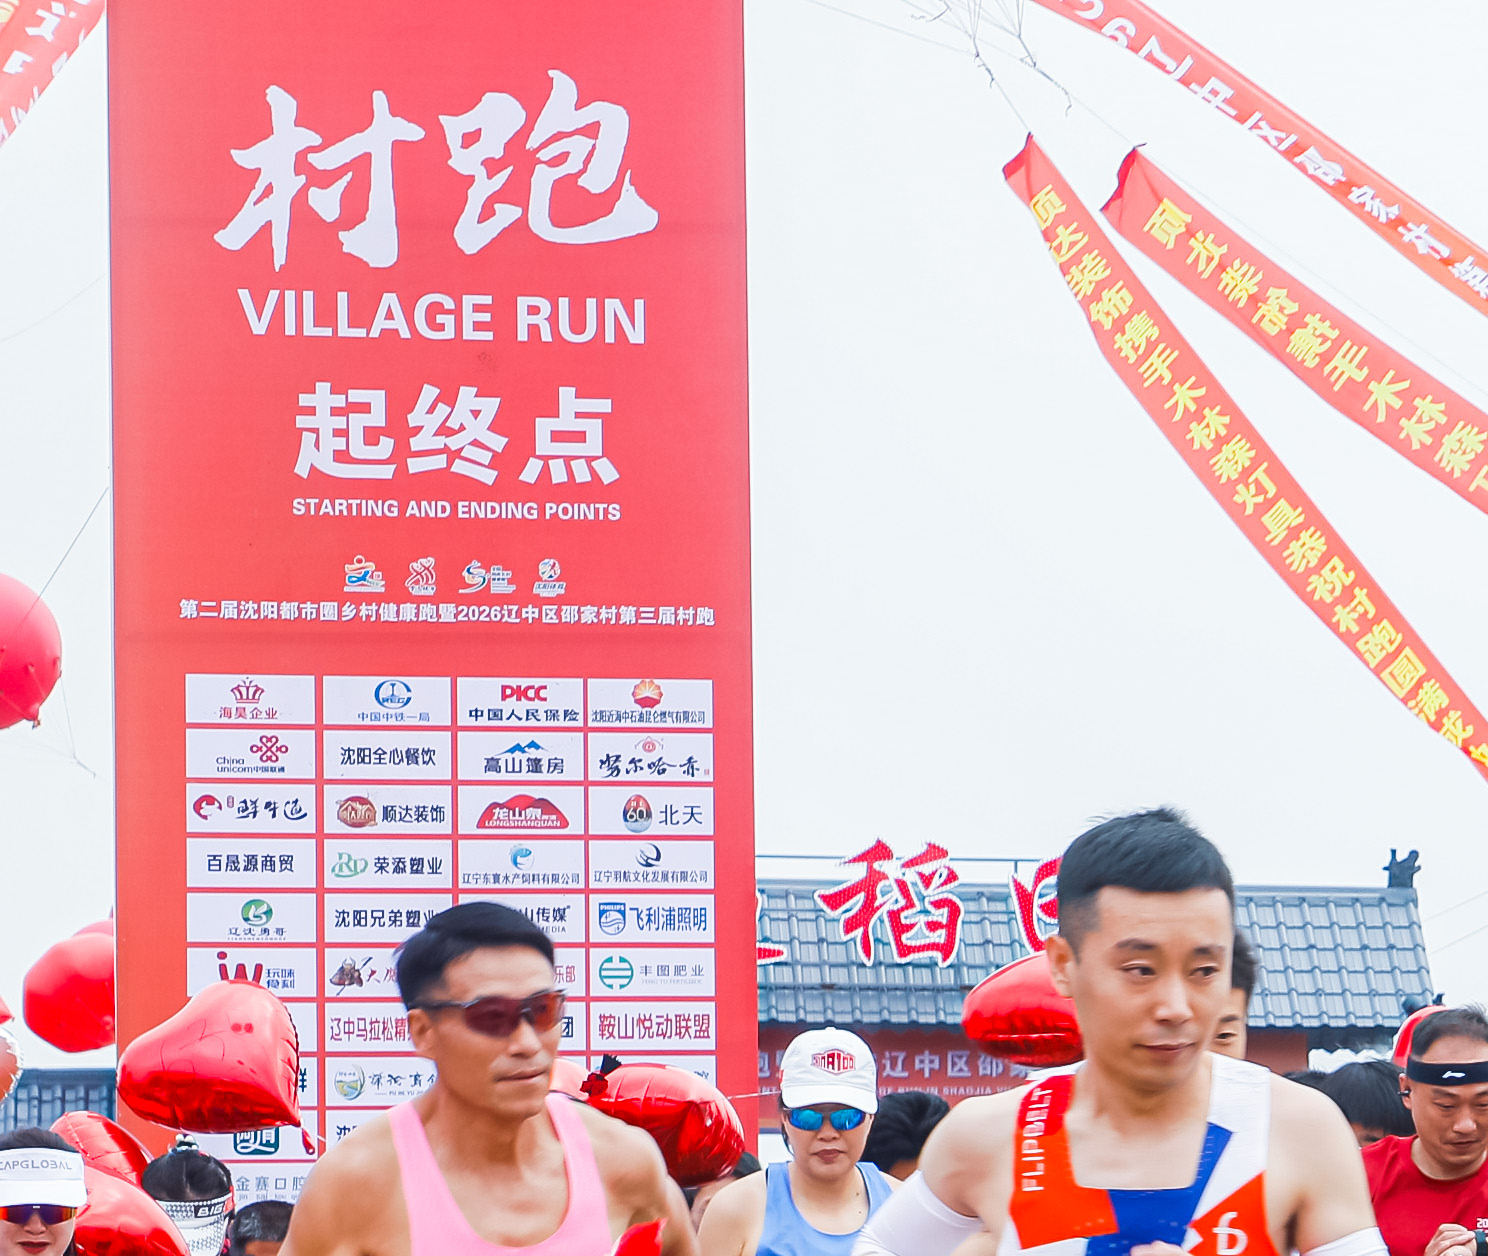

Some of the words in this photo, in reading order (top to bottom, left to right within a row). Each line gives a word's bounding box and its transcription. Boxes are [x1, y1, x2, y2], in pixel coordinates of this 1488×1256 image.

[213, 69, 659, 272] 村跑
[238, 288, 494, 342] VILLAGE
[517, 295, 646, 345] RUN
[294, 382, 620, 487] 起终点
[292, 498, 399, 520] STARTING
[404, 500, 451, 521] AND
[457, 501, 539, 522] ENDING
[544, 502, 622, 523] POINTS
[179, 598, 716, 628] 第二届沈阳都市圈乡村健康跑暨2026辽中区邵家村第三届村跑
[501, 684, 548, 702] PICC
[357, 711, 430, 723] 中国中铁一局
[468, 708, 580, 722] 中国人民保险
[216, 756, 245, 765] China
[340, 746, 436, 766] 沈阳全心餐饮
[484, 757, 565, 774] 高山篷房
[381, 804, 446, 824] 顺达装饰
[485, 819, 562, 828] LONGSHANQUAN
[658, 804, 703, 826] 北天
[206, 853, 294, 874] 百晟源商贸
[374, 856, 442, 875] 荣添塑业
[629, 906, 708, 932] 飞利浦照明
[329, 1017, 412, 1043] 辽中马拉松精
[598, 1013, 711, 1040] 鞍山悦动联盟
